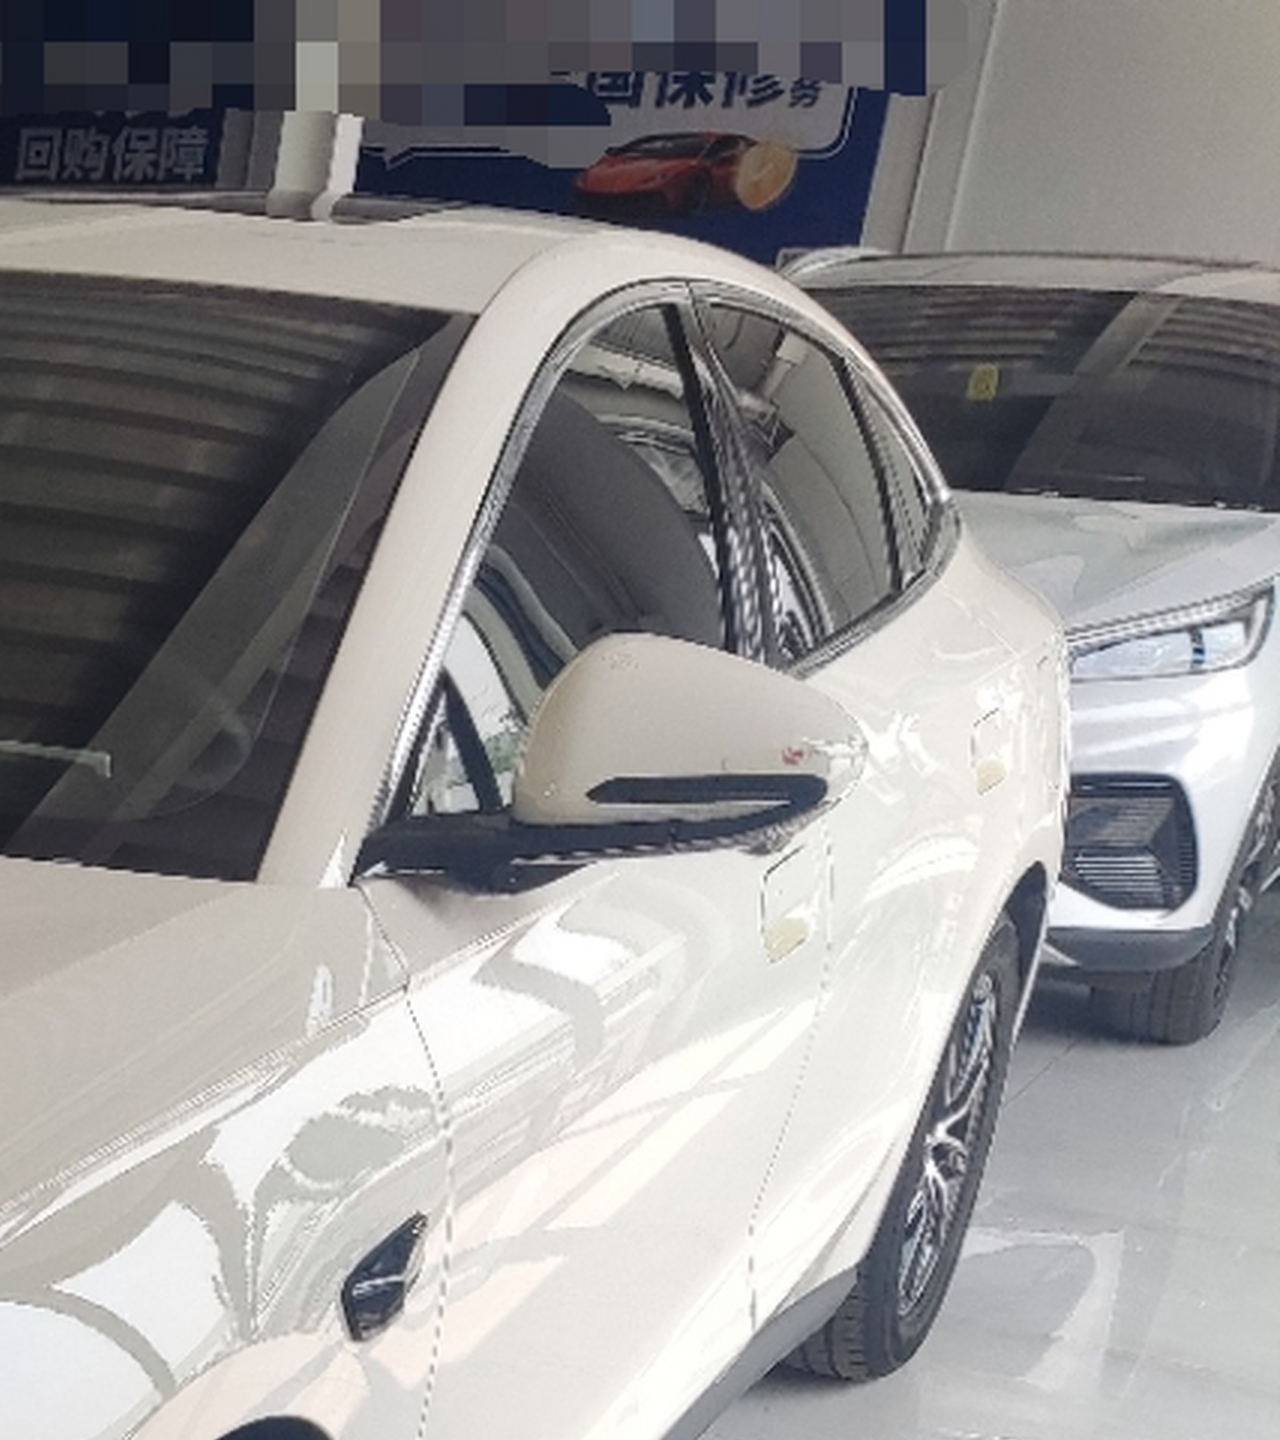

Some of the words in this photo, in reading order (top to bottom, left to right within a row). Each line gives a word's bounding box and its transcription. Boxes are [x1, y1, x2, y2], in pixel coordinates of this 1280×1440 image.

[550, 71, 785, 109] 国保修
[15, 125, 208, 180] 回购保障
